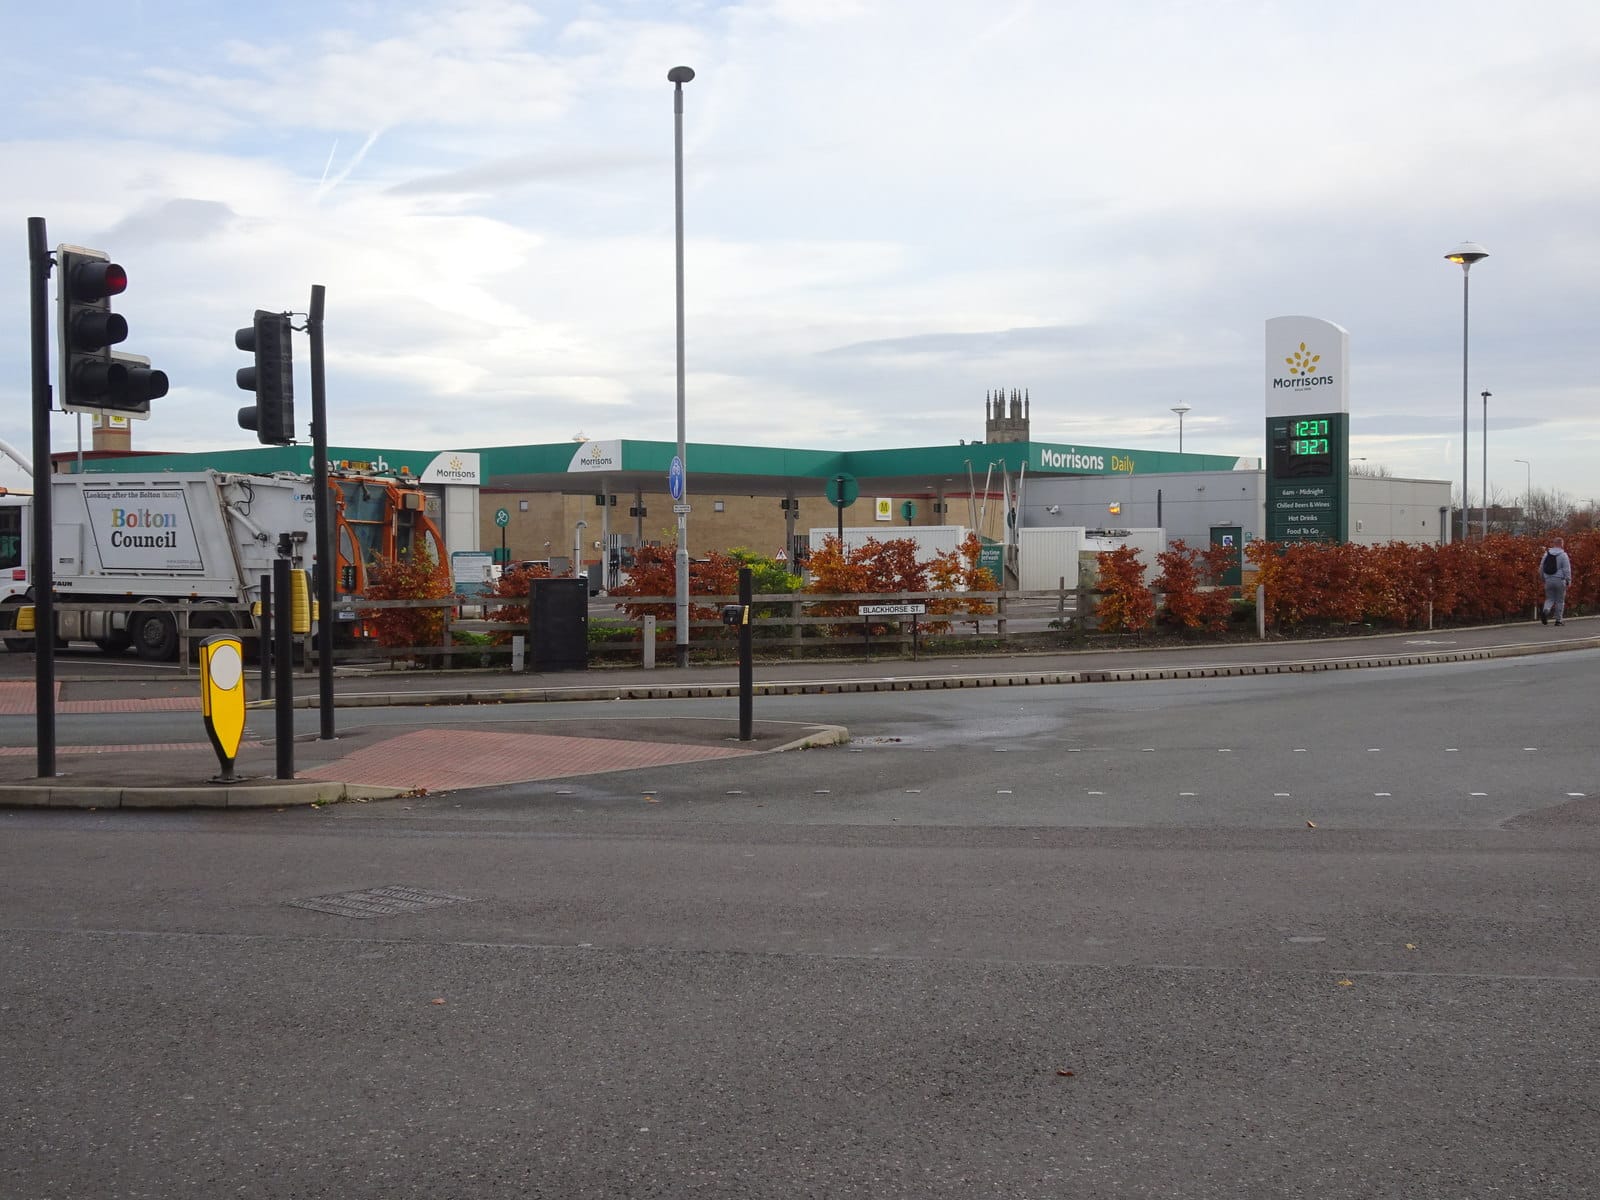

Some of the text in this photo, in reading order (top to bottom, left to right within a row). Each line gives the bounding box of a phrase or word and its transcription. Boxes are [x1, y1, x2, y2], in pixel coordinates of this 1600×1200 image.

[1273, 372, 1334, 389] Morrisons
[580, 457, 613, 466] Morrisons
[1041, 447, 1135, 476] Morrisons Daily
[436, 468, 476, 479] Morrisons
[86, 491, 111, 499] Looking
[111, 491, 127, 499] after
[128, 490, 139, 498] the
[140, 490, 160, 498] Bolton
[1299, 488, 1324, 496] Midnight
[111, 508, 177, 528] Bolton
[111, 530, 177, 548] Council
[862, 605, 921, 614] BLACKHORSE ST.
